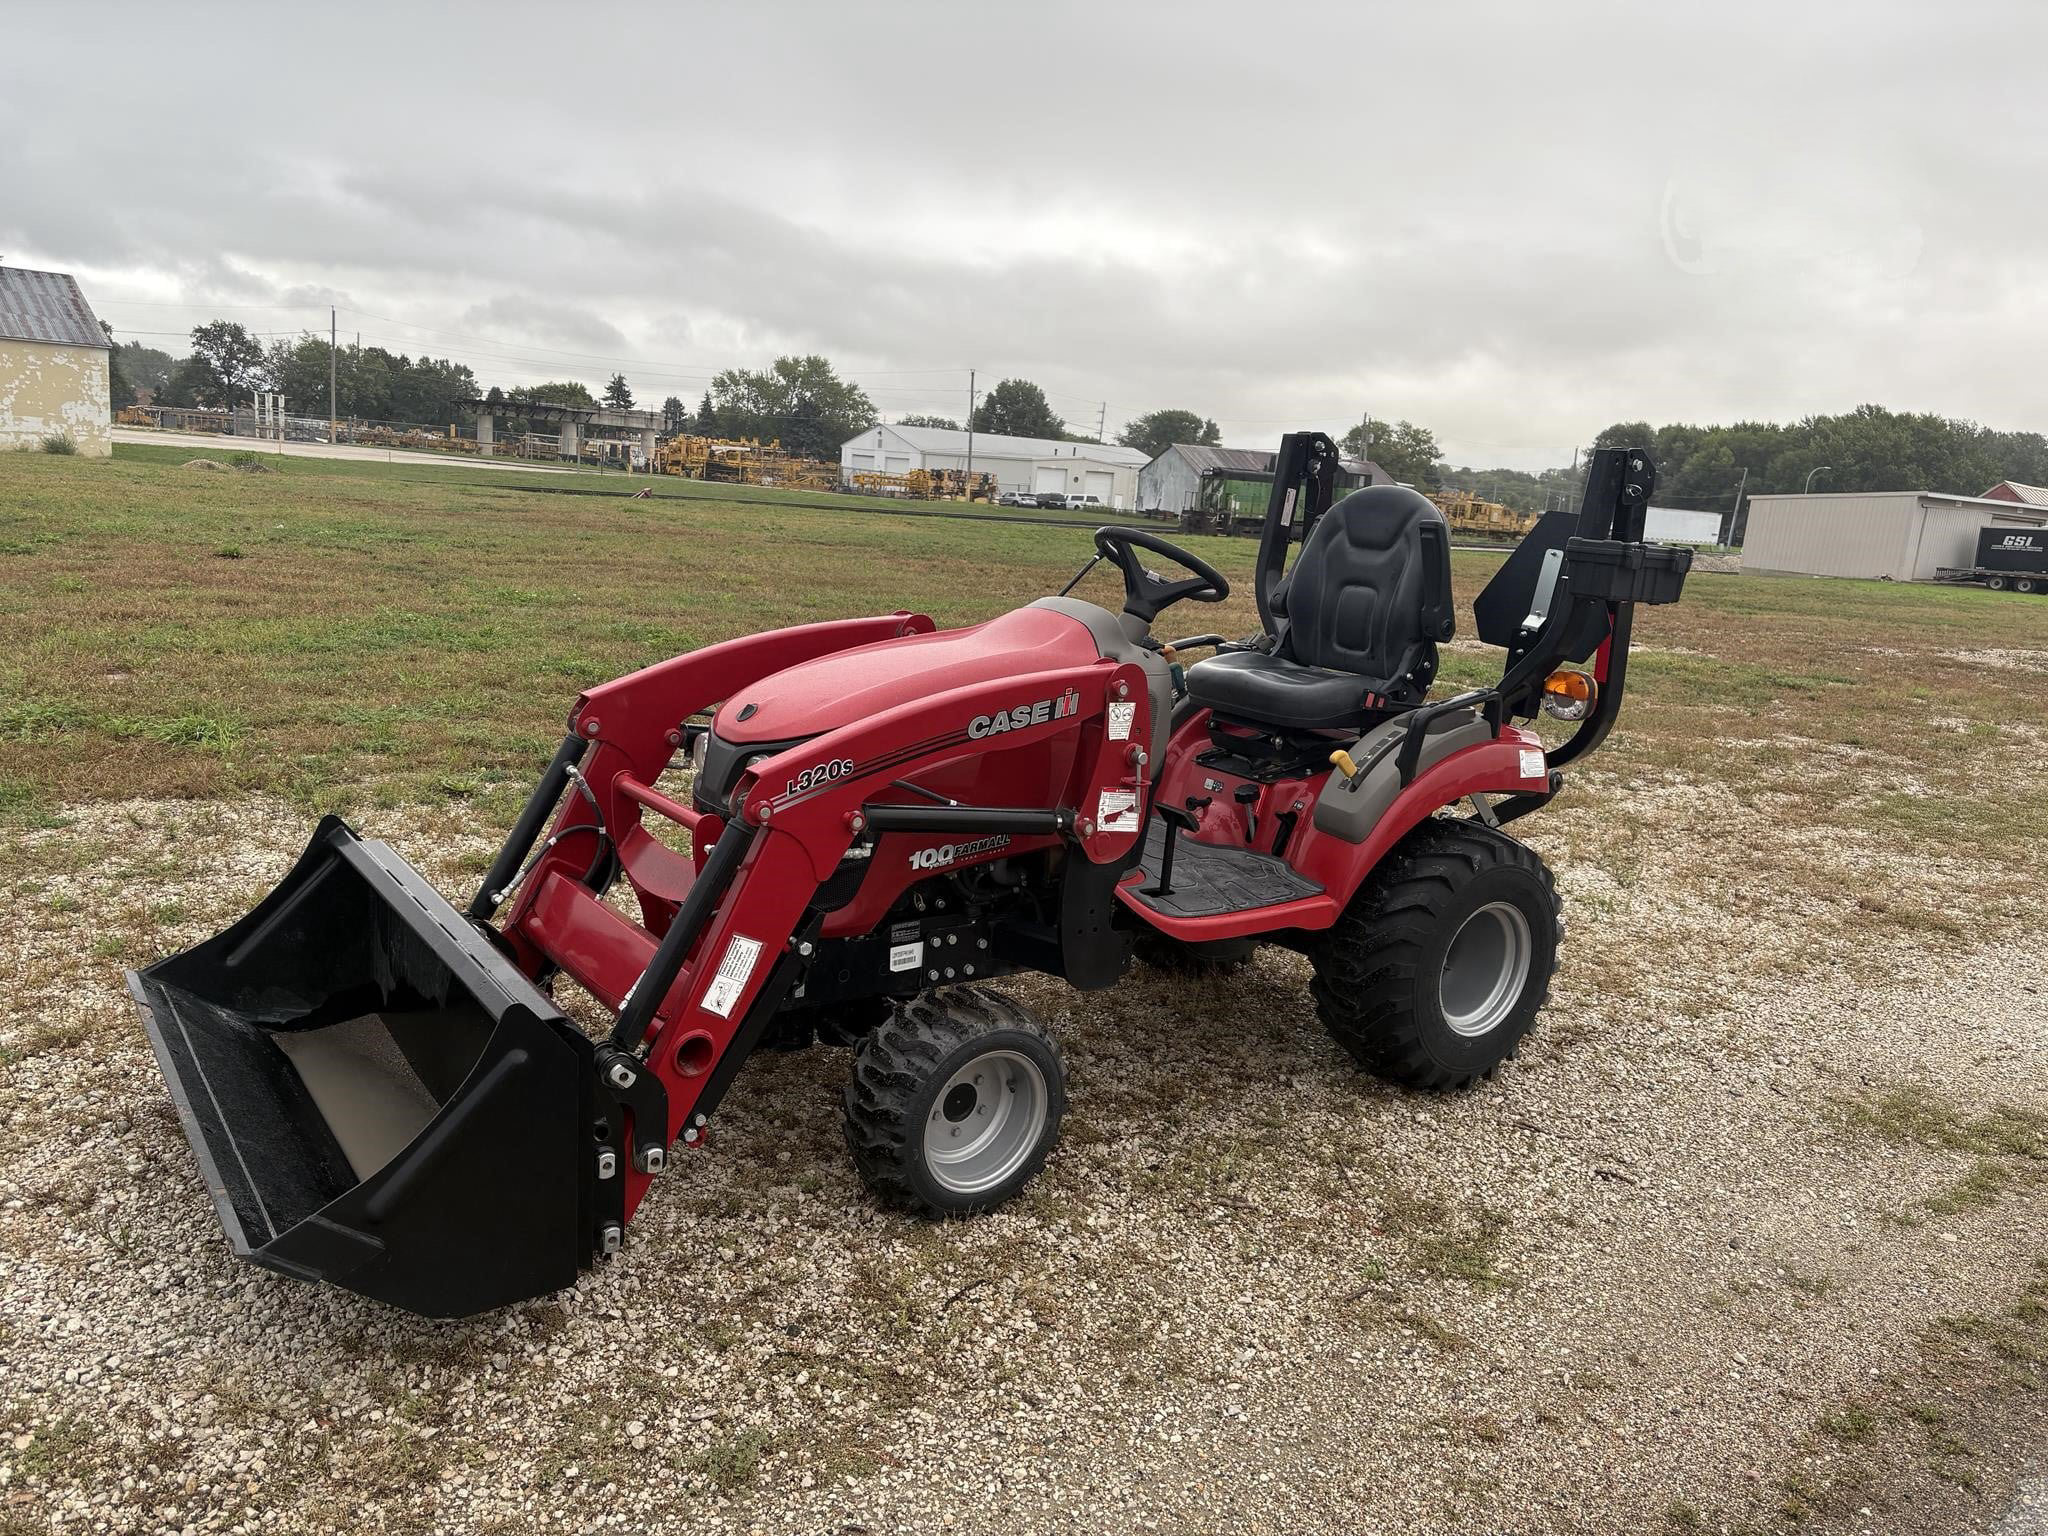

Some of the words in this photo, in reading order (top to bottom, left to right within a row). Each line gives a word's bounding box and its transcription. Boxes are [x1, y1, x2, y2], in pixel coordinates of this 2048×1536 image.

[2002, 535, 2033, 547] GSI
[967, 699, 1051, 740] CASE
[908, 844, 955, 870] 100
[954, 833, 1011, 857] FARMALL
